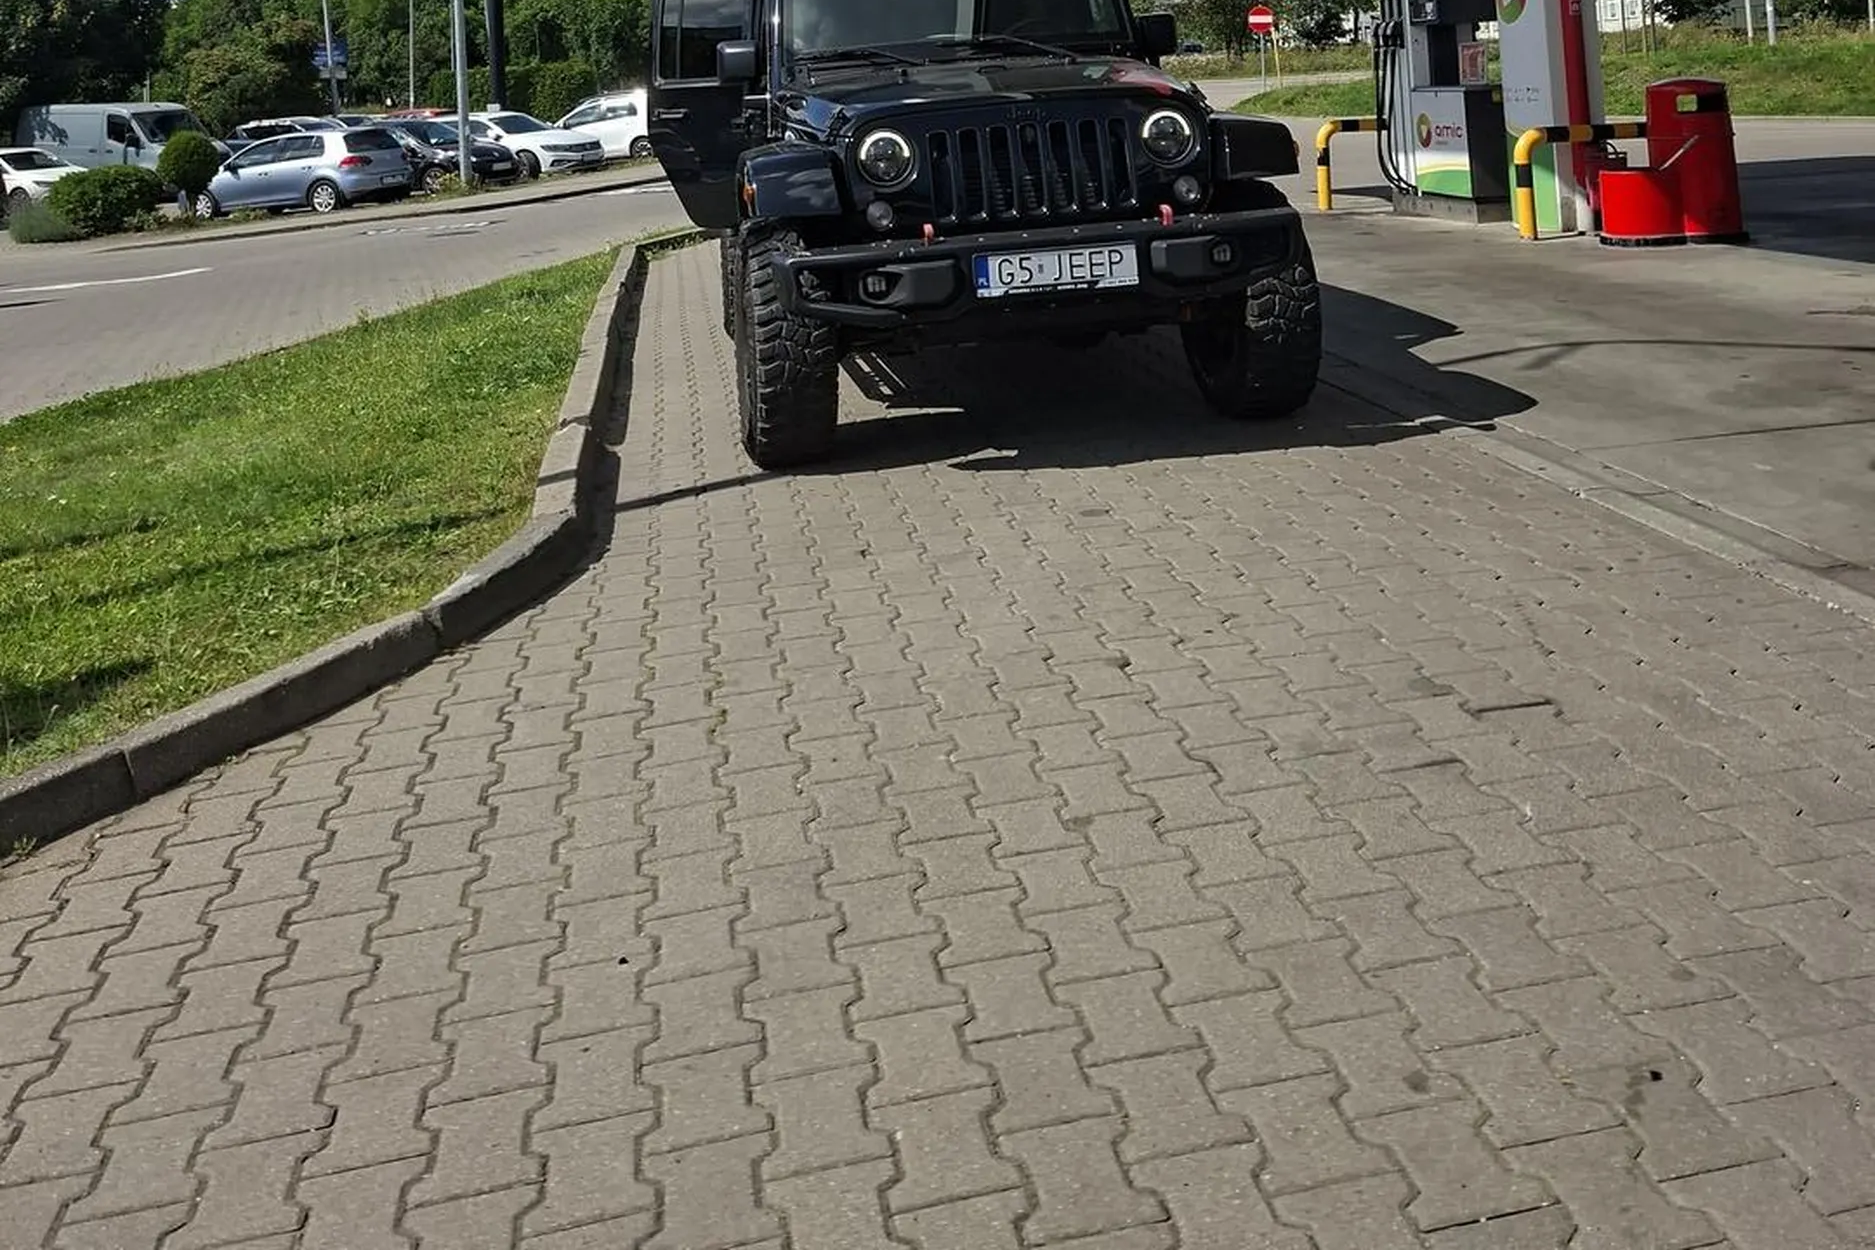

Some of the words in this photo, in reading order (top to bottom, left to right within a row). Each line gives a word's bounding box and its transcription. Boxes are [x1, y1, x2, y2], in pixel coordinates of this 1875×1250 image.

[1434, 122, 1464, 139] amic
[998, 256, 1034, 286] G5
[1053, 249, 1124, 282] JEEP
